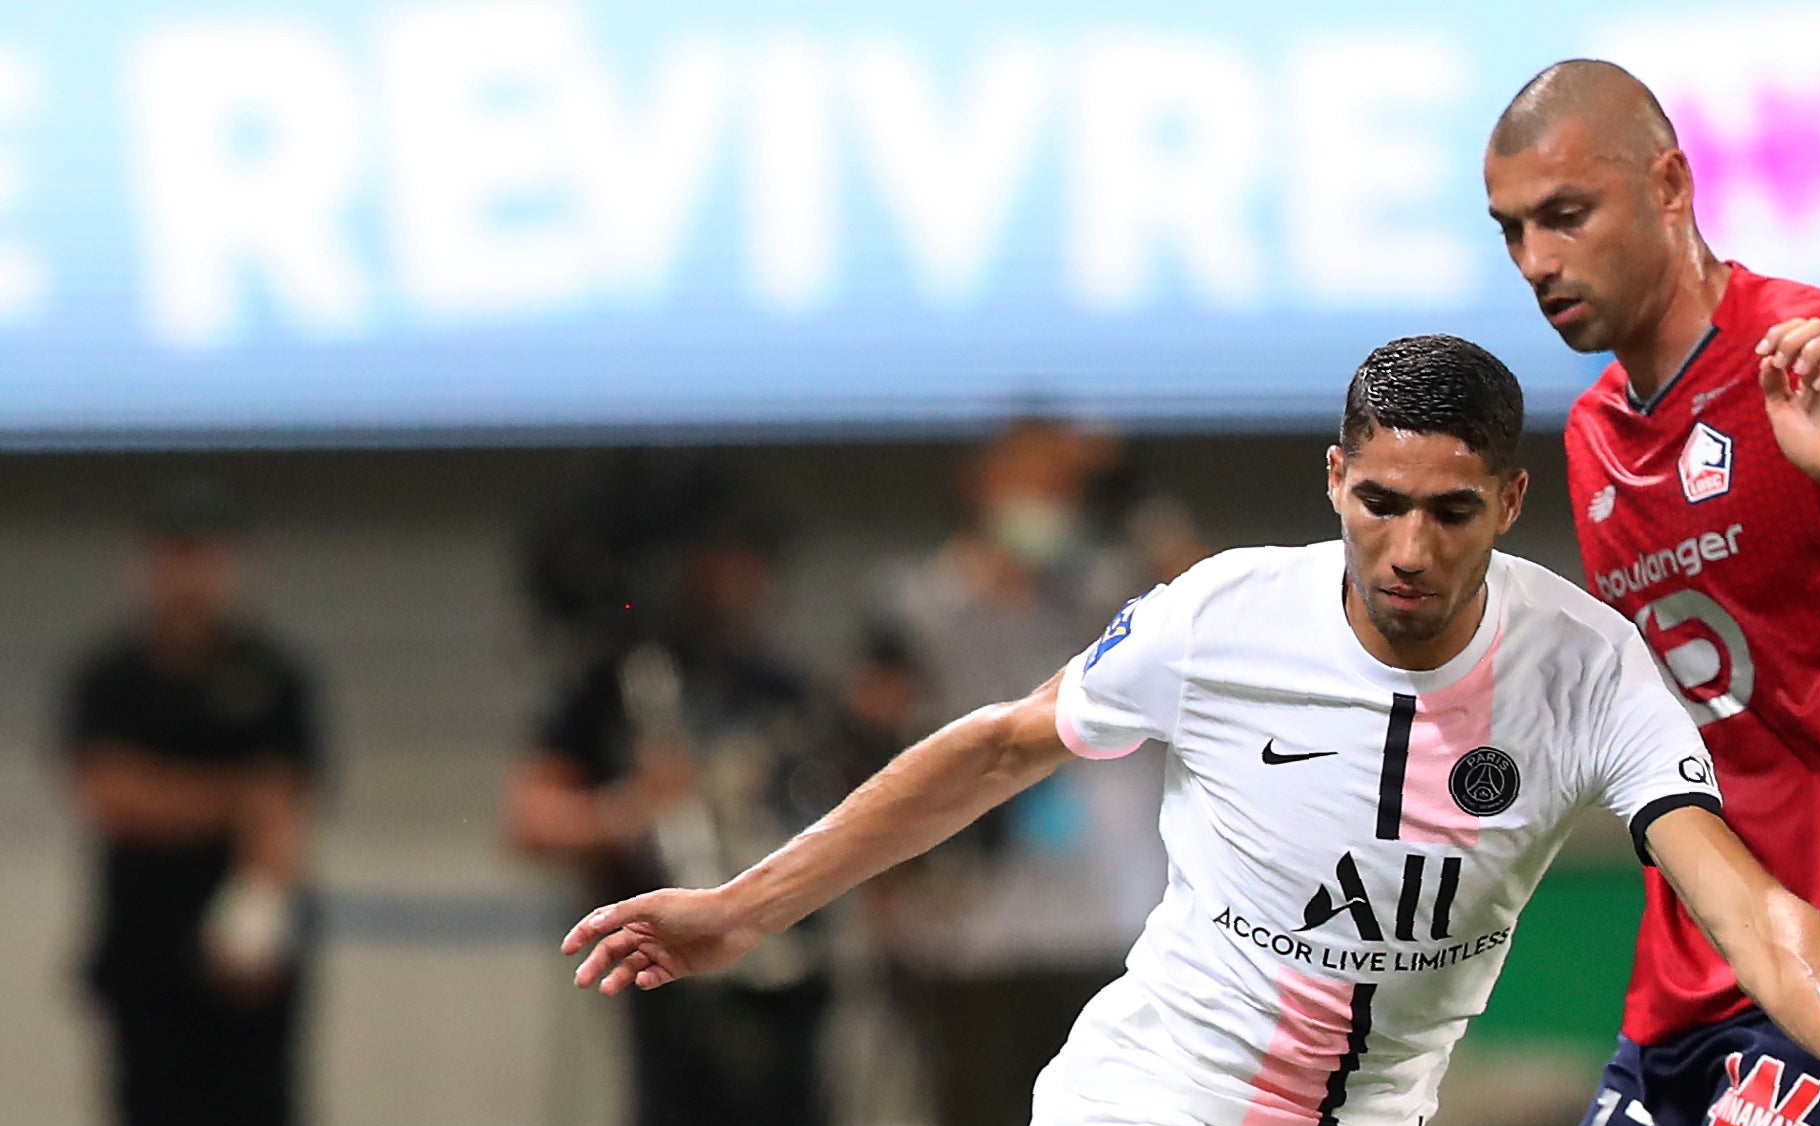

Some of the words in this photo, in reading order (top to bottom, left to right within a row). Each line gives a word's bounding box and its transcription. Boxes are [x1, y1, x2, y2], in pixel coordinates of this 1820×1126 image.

[1594, 523, 1744, 600] boulanger
[1466, 752, 1510, 771] PARIS
[1213, 906, 1313, 964] ACCOR
[1322, 948, 1386, 972] LIVE
[1394, 927, 1511, 972] LIMITLESS
